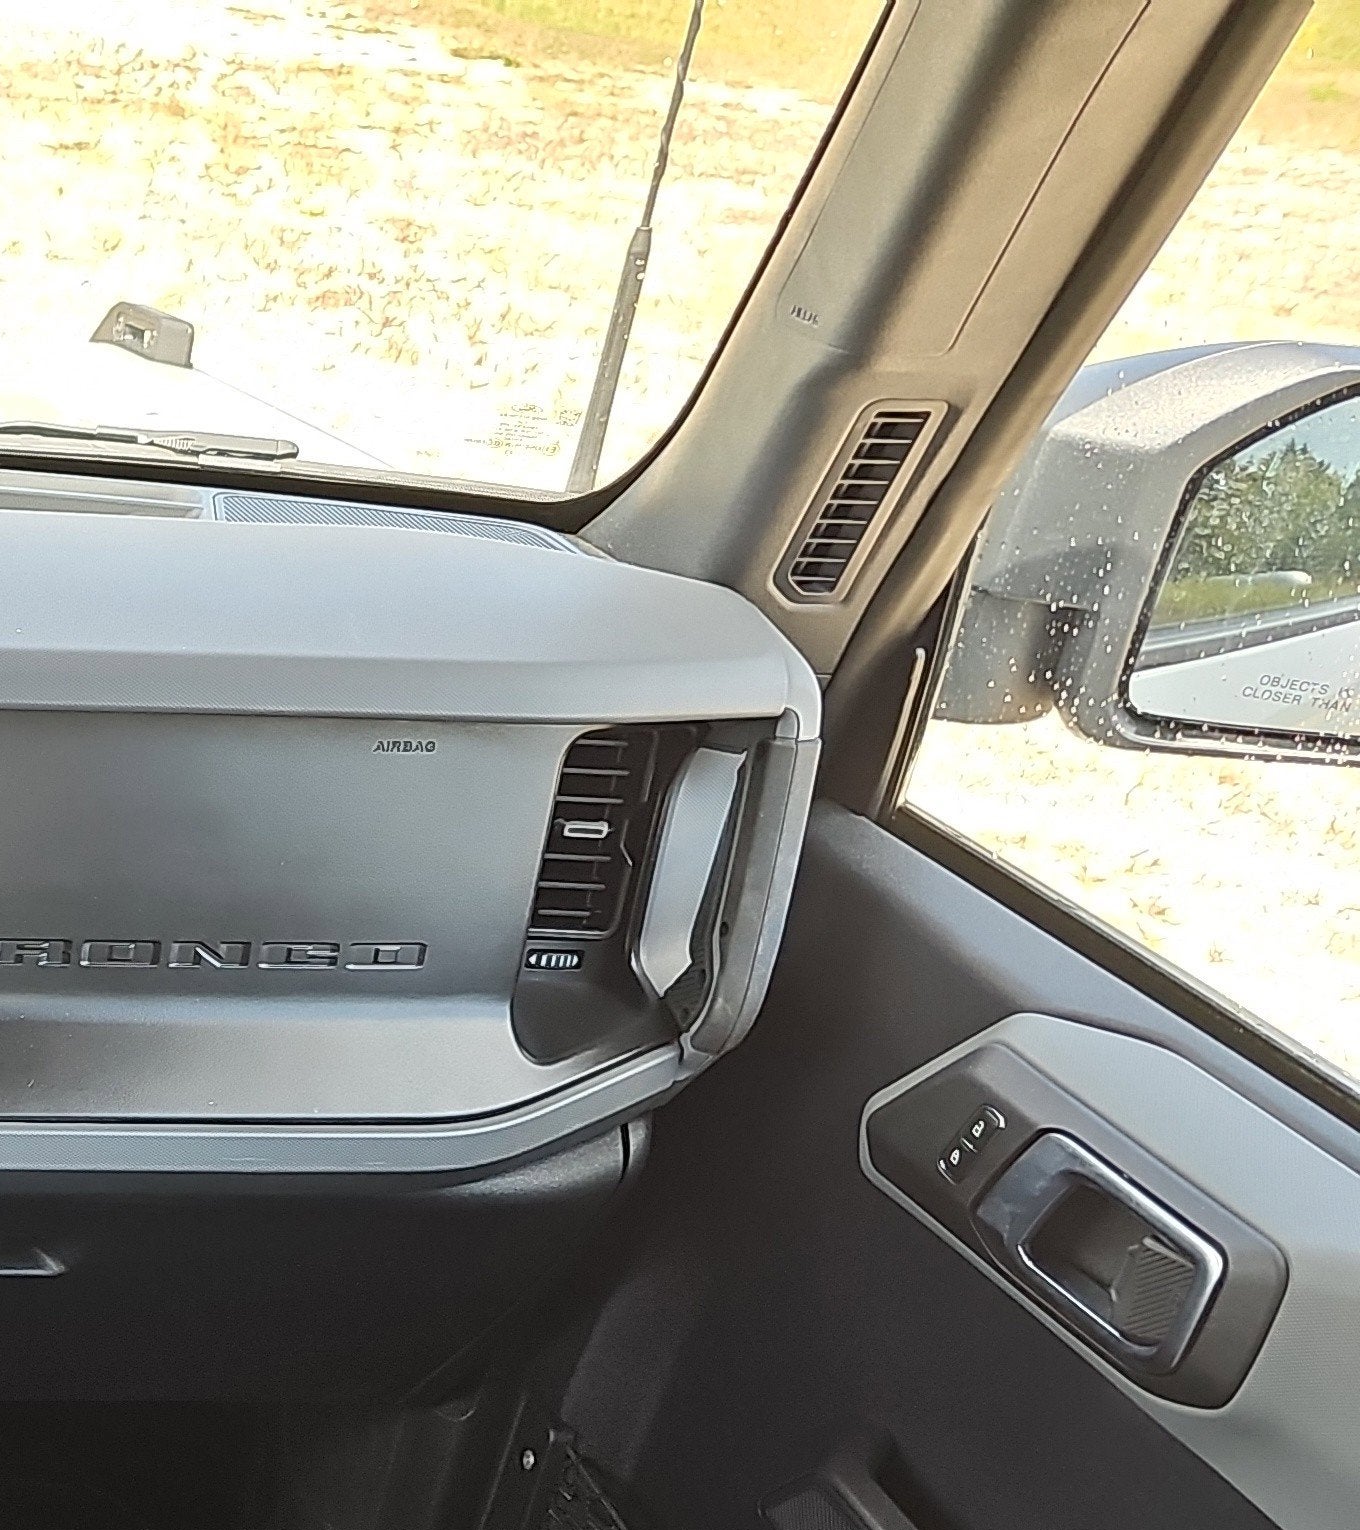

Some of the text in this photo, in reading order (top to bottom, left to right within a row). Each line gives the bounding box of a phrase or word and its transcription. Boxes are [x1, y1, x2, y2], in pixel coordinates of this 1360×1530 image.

[1259, 674, 1330, 695] OBJECTS
[1242, 686, 1352, 712] CLOSER THAN
[373, 741, 436, 752] AIRBAG
